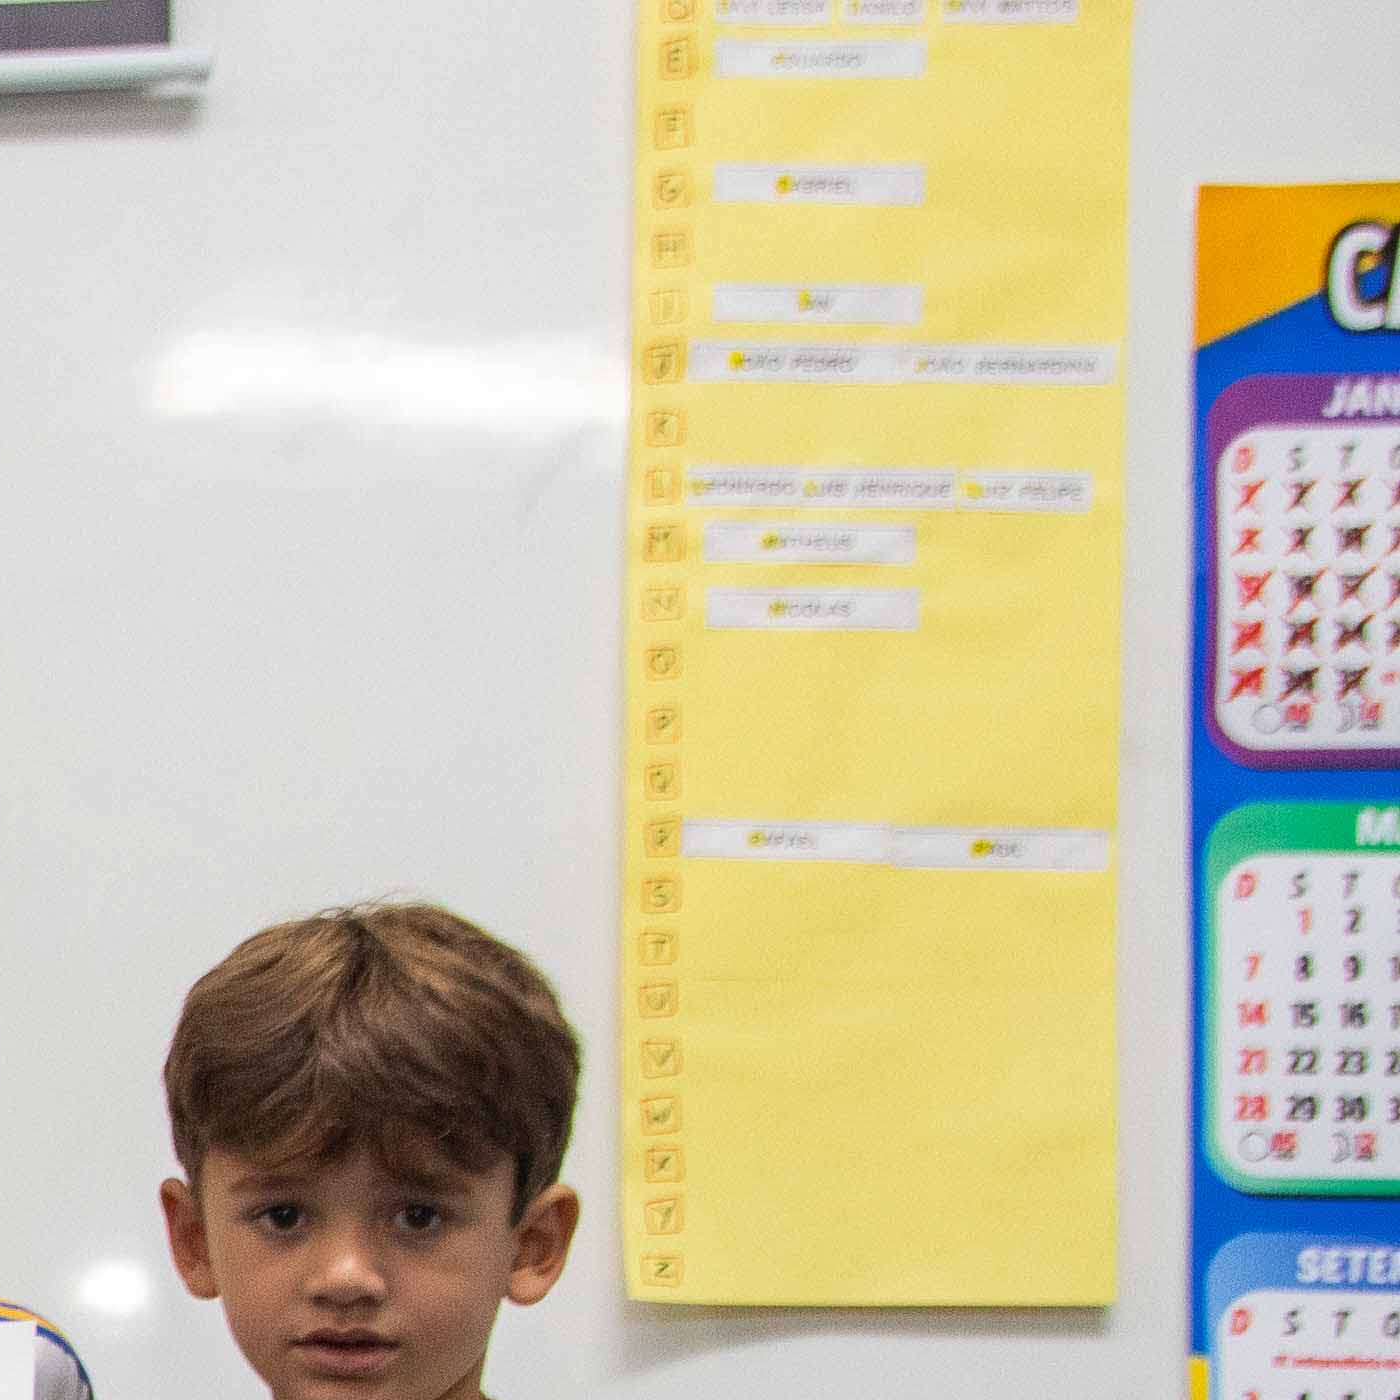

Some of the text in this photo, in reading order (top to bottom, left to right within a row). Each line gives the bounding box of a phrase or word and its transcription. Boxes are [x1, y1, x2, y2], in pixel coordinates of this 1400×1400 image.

[1234, 871, 1360, 900] D S T
[1343, 909, 1362, 936] 2
[1246, 953, 1262, 982] 7
[1289, 1001, 1318, 1029] 15
[1338, 1002, 1367, 1029] 16
[1286, 1048, 1317, 1076] 22
[1335, 1048, 1367, 1076] 23
[1286, 1095, 1318, 1122] 29
[1335, 1095, 1367, 1122] 30
[1296, 1248, 1400, 1284] SETE
[1229, 1308, 1252, 1337] D
[1283, 1309, 1300, 1337] S
[1333, 1310, 1351, 1339] T
